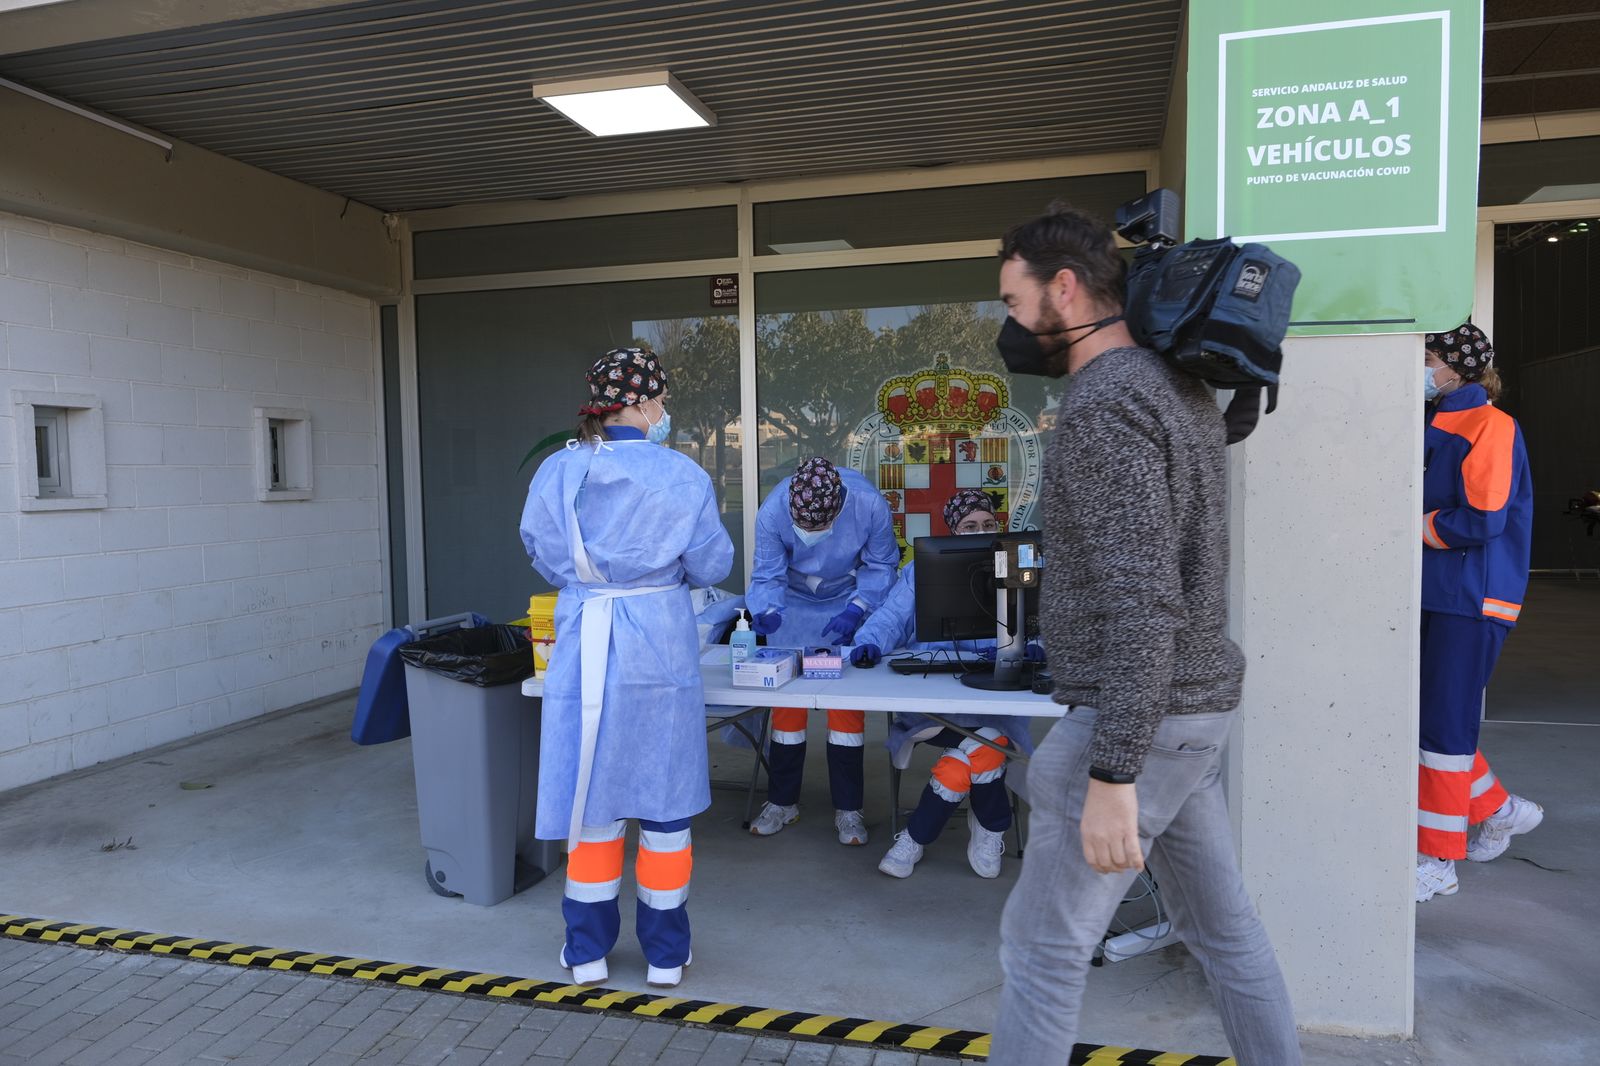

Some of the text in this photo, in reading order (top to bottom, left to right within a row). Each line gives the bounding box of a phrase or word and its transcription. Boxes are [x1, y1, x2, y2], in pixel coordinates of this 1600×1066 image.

[1251, 75, 1408, 98] SERVICIO ANDALUZ DE SALUD
[1256, 102, 1342, 129] ZONA
[1246, 133, 1412, 167] VEHÍCULOS
[1246, 165, 1411, 185] PUNTO DE VACUNACIÓN COVID
[1012, 439, 1037, 529] POR LA LIBERTAD
[763, 676, 774, 687] M
